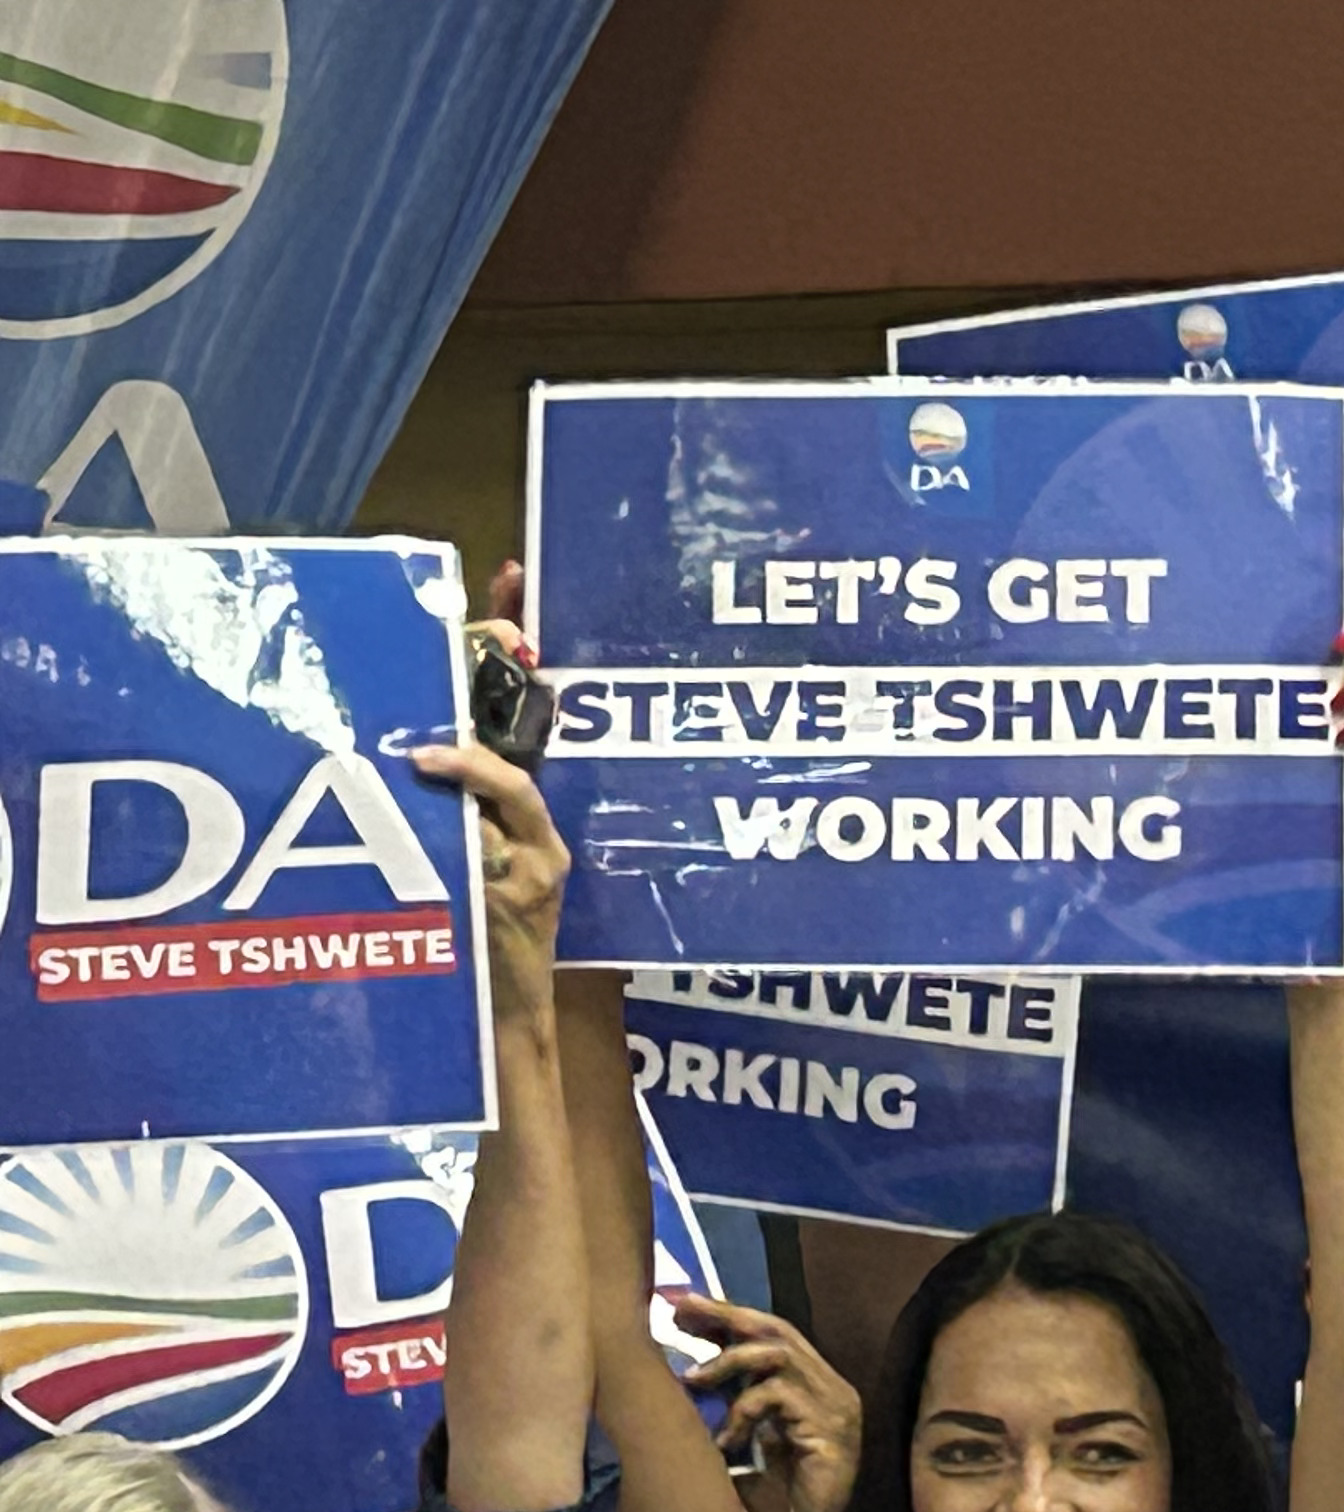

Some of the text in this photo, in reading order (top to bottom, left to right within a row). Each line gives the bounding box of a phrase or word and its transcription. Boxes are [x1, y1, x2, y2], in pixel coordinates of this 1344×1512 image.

[910, 463, 970, 492] DA
[711, 556, 1168, 627] LET'S GET
[558, 677, 1330, 742] STEVE TSHWETE
[36, 755, 450, 924] DA
[713, 794, 1182, 862] WORKING
[38, 928, 456, 984] STEVE TSHWETE
[624, 1032, 919, 1130] ORKING
[341, 1334, 447, 1379] STEV
